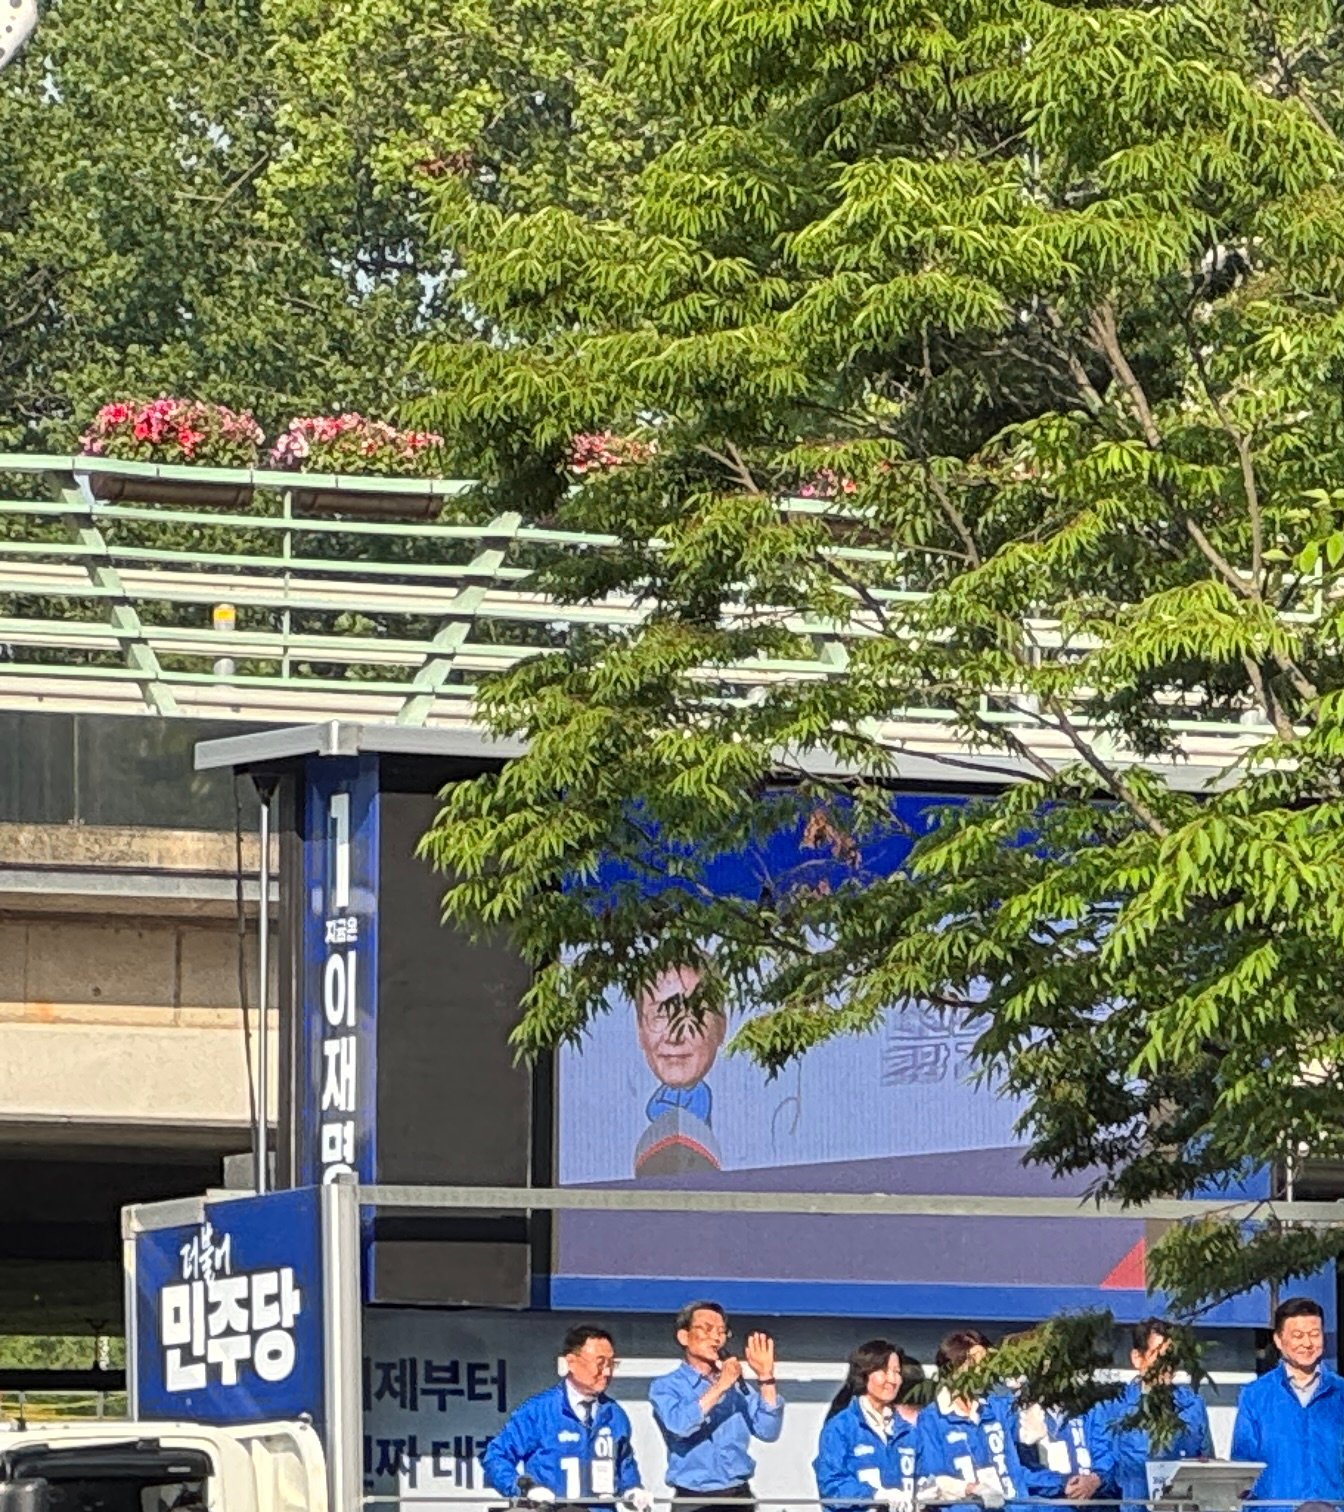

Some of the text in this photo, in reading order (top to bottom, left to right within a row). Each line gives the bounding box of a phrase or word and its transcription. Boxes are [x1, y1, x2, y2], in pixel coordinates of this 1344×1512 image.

[331, 793, 349, 907] 1
[325, 917, 358, 944] 지금은
[321, 949, 357, 1185] 이재명
[180, 1222, 231, 1288] 더불어
[162, 1267, 300, 1392] 민주당
